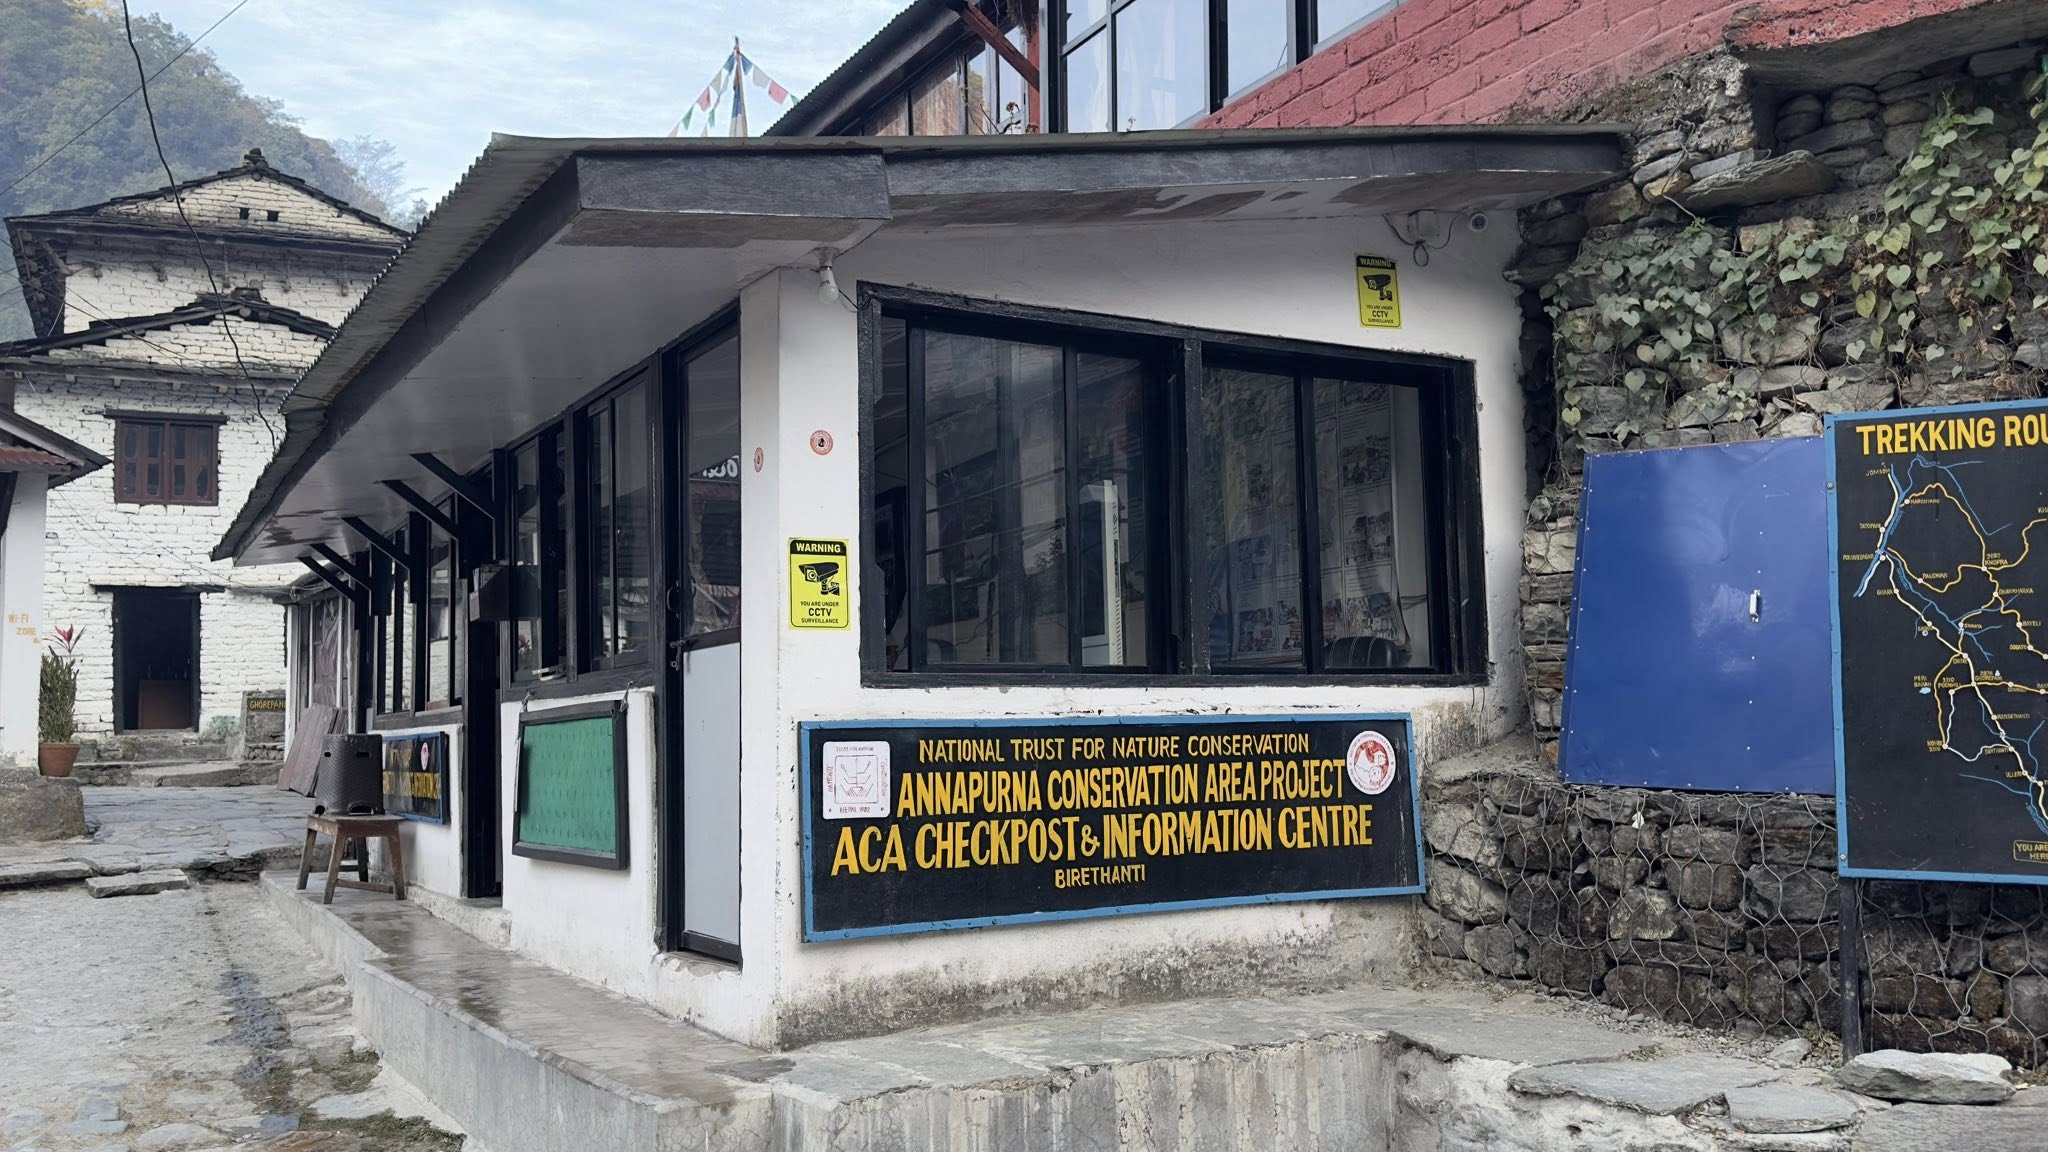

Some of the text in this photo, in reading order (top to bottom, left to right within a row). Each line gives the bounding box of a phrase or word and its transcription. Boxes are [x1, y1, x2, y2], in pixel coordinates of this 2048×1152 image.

[1360, 258, 1391, 267] WARNING
[1372, 310, 1388, 318] CCTV
[1856, 417, 1995, 455] TREKKING
[796, 543, 841, 553] WARNING
[808, 608, 832, 617] CCTV
[919, 734, 1309, 763] NATIONAL TRUST FOR NATURE CONSERVATION
[897, 768, 1041, 817] ANNAPURNA
[1048, 762, 1199, 811] CONSERVATION
[1205, 760, 1256, 801] AREA
[1261, 760, 1345, 801] PROJECT
[840, 806, 857, 814] NEPAL
[832, 804, 1372, 876] ACA CHECKPOST & INFORMATION CENTRE
[2016, 844, 2033, 852] YOU
[1056, 864, 1145, 888] BIRETHANTI
